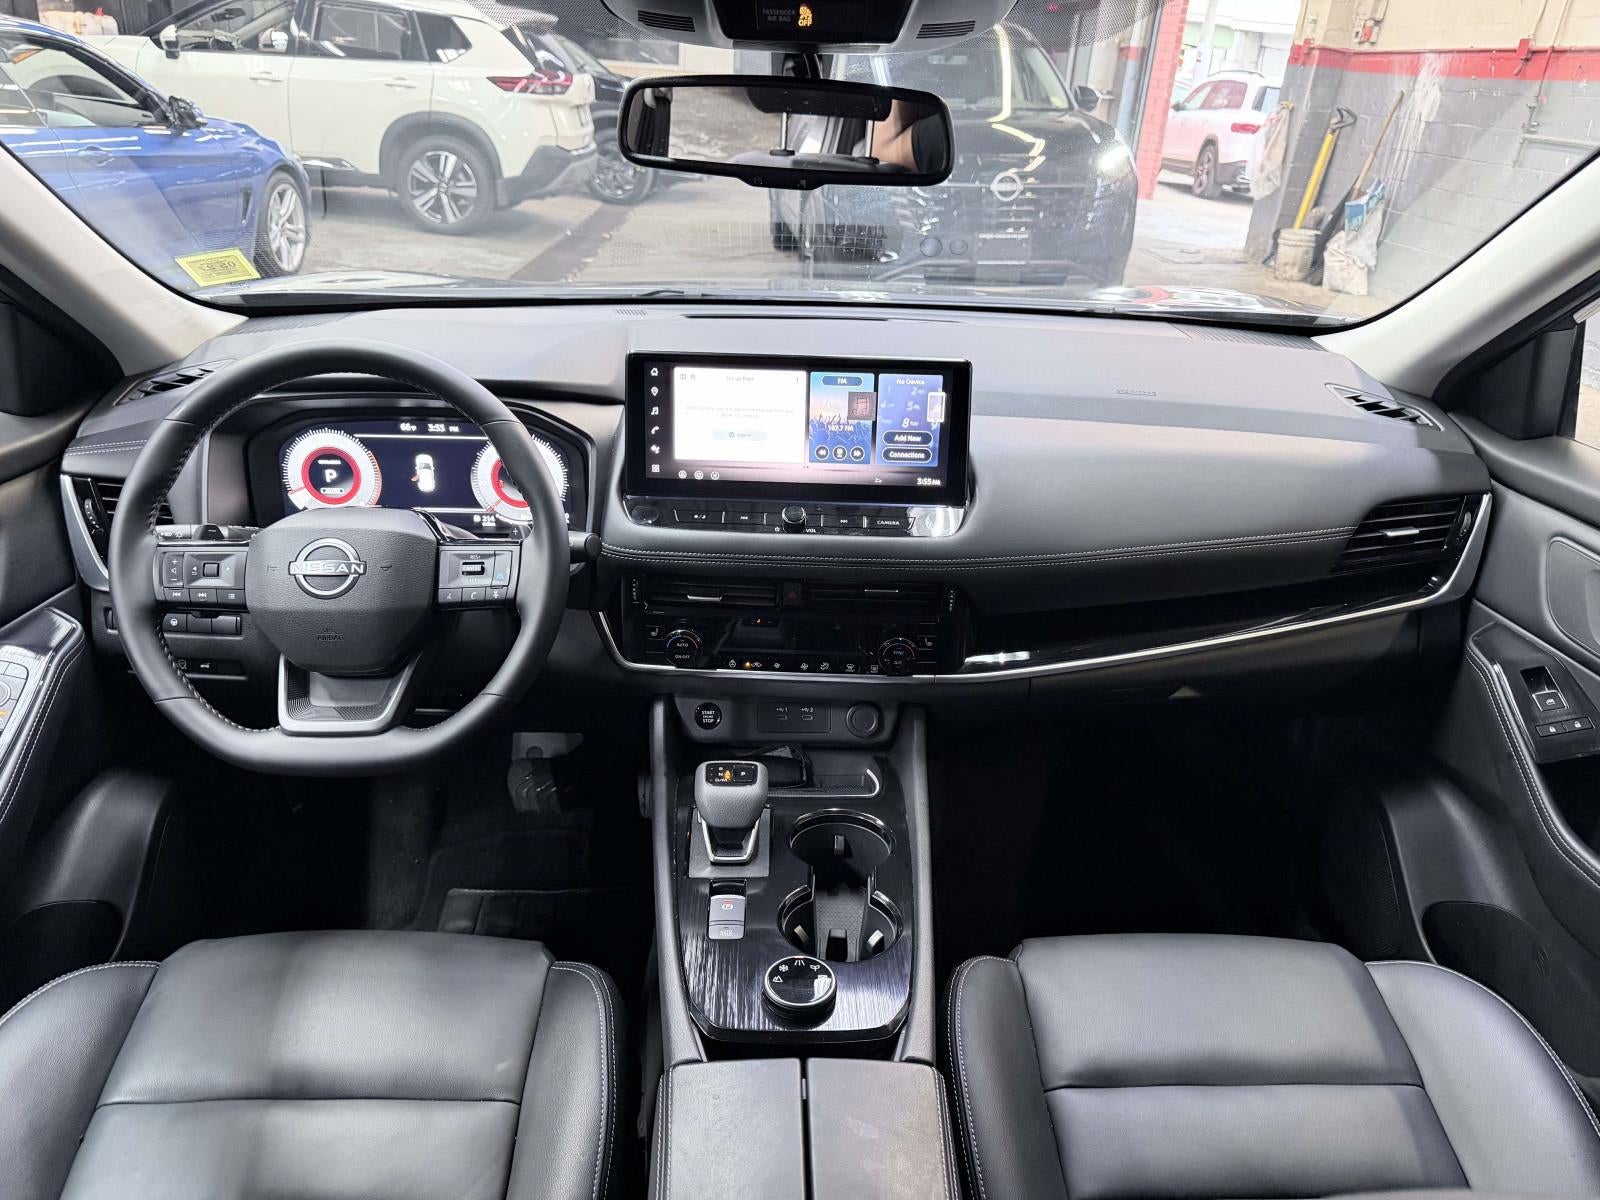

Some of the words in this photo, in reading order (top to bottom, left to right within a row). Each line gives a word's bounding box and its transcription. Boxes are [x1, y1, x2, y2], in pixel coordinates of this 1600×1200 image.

[427, 423, 445, 432] 3:55
[894, 434, 907, 442] Add
[889, 451, 925, 459] Connections
[324, 469, 338, 483] P
[291, 562, 364, 575] NISSAN
